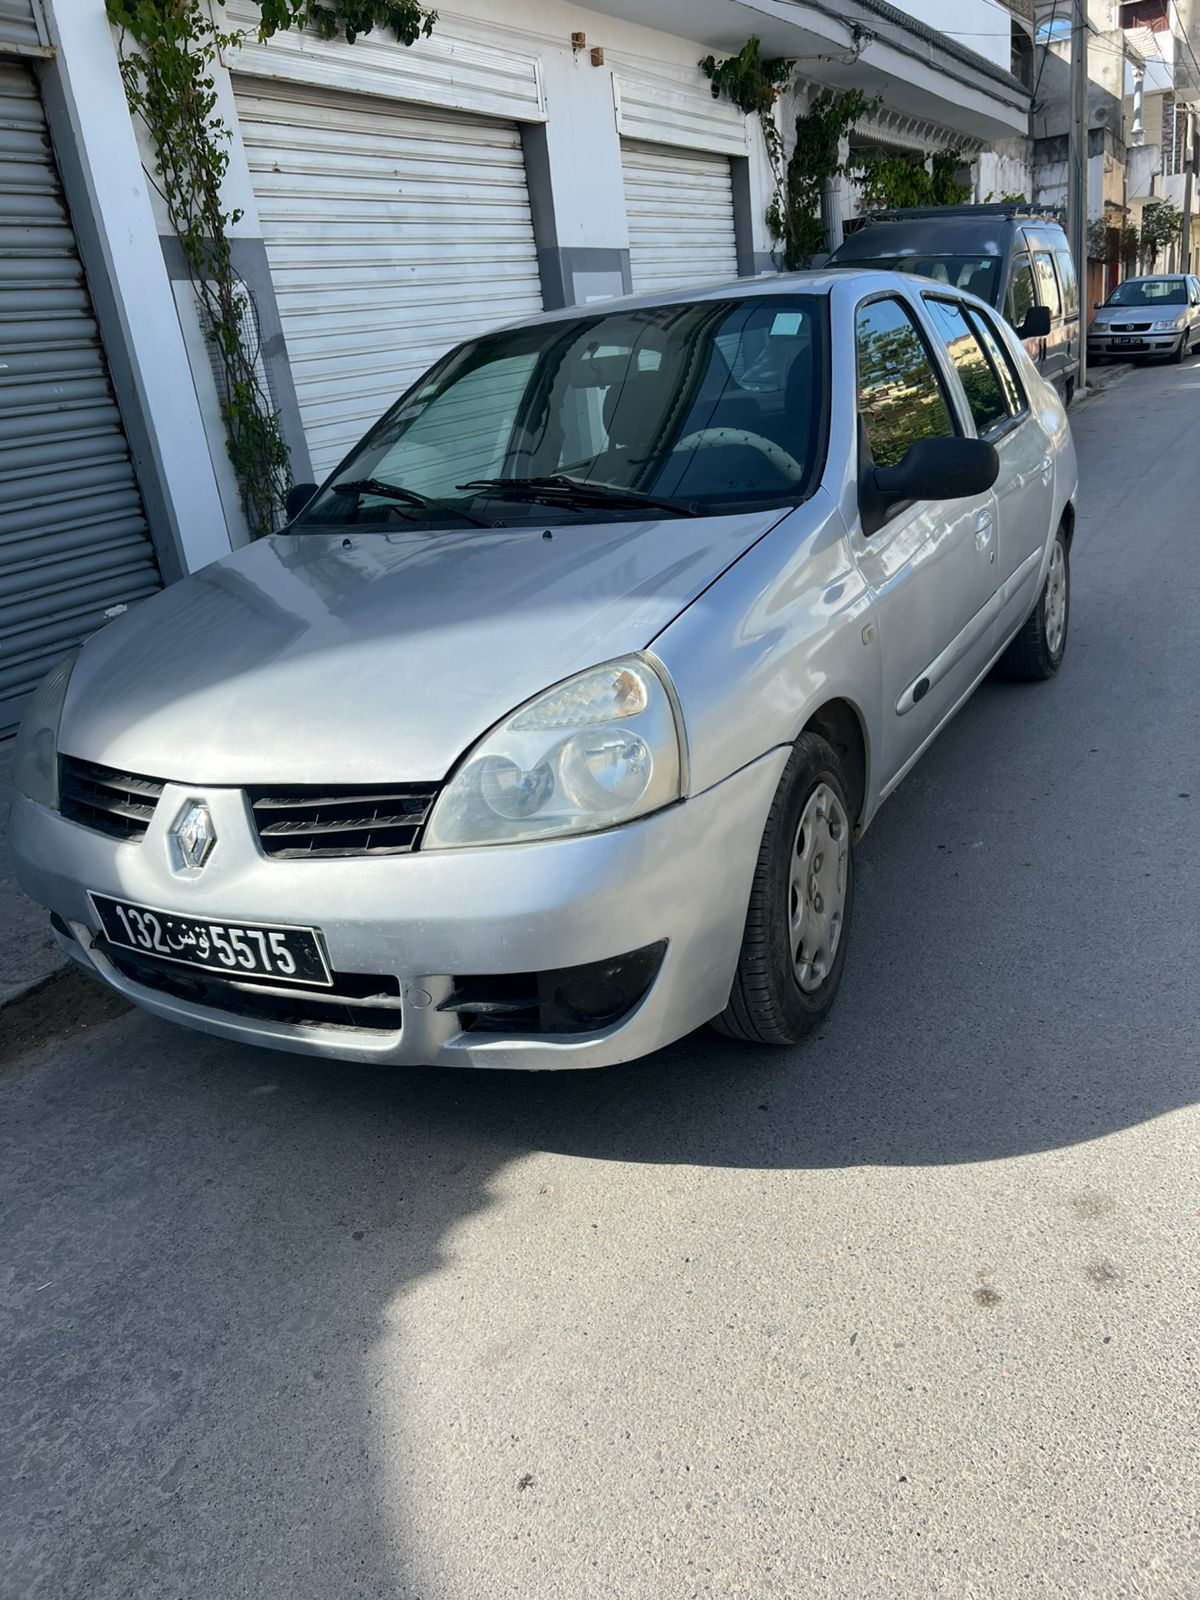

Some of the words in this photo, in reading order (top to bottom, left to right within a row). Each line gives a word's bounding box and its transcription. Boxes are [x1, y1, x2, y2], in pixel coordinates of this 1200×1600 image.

[116, 905, 171, 953] 132
[167, 923, 210, 959] تونس
[209, 926, 296, 974] 5575
